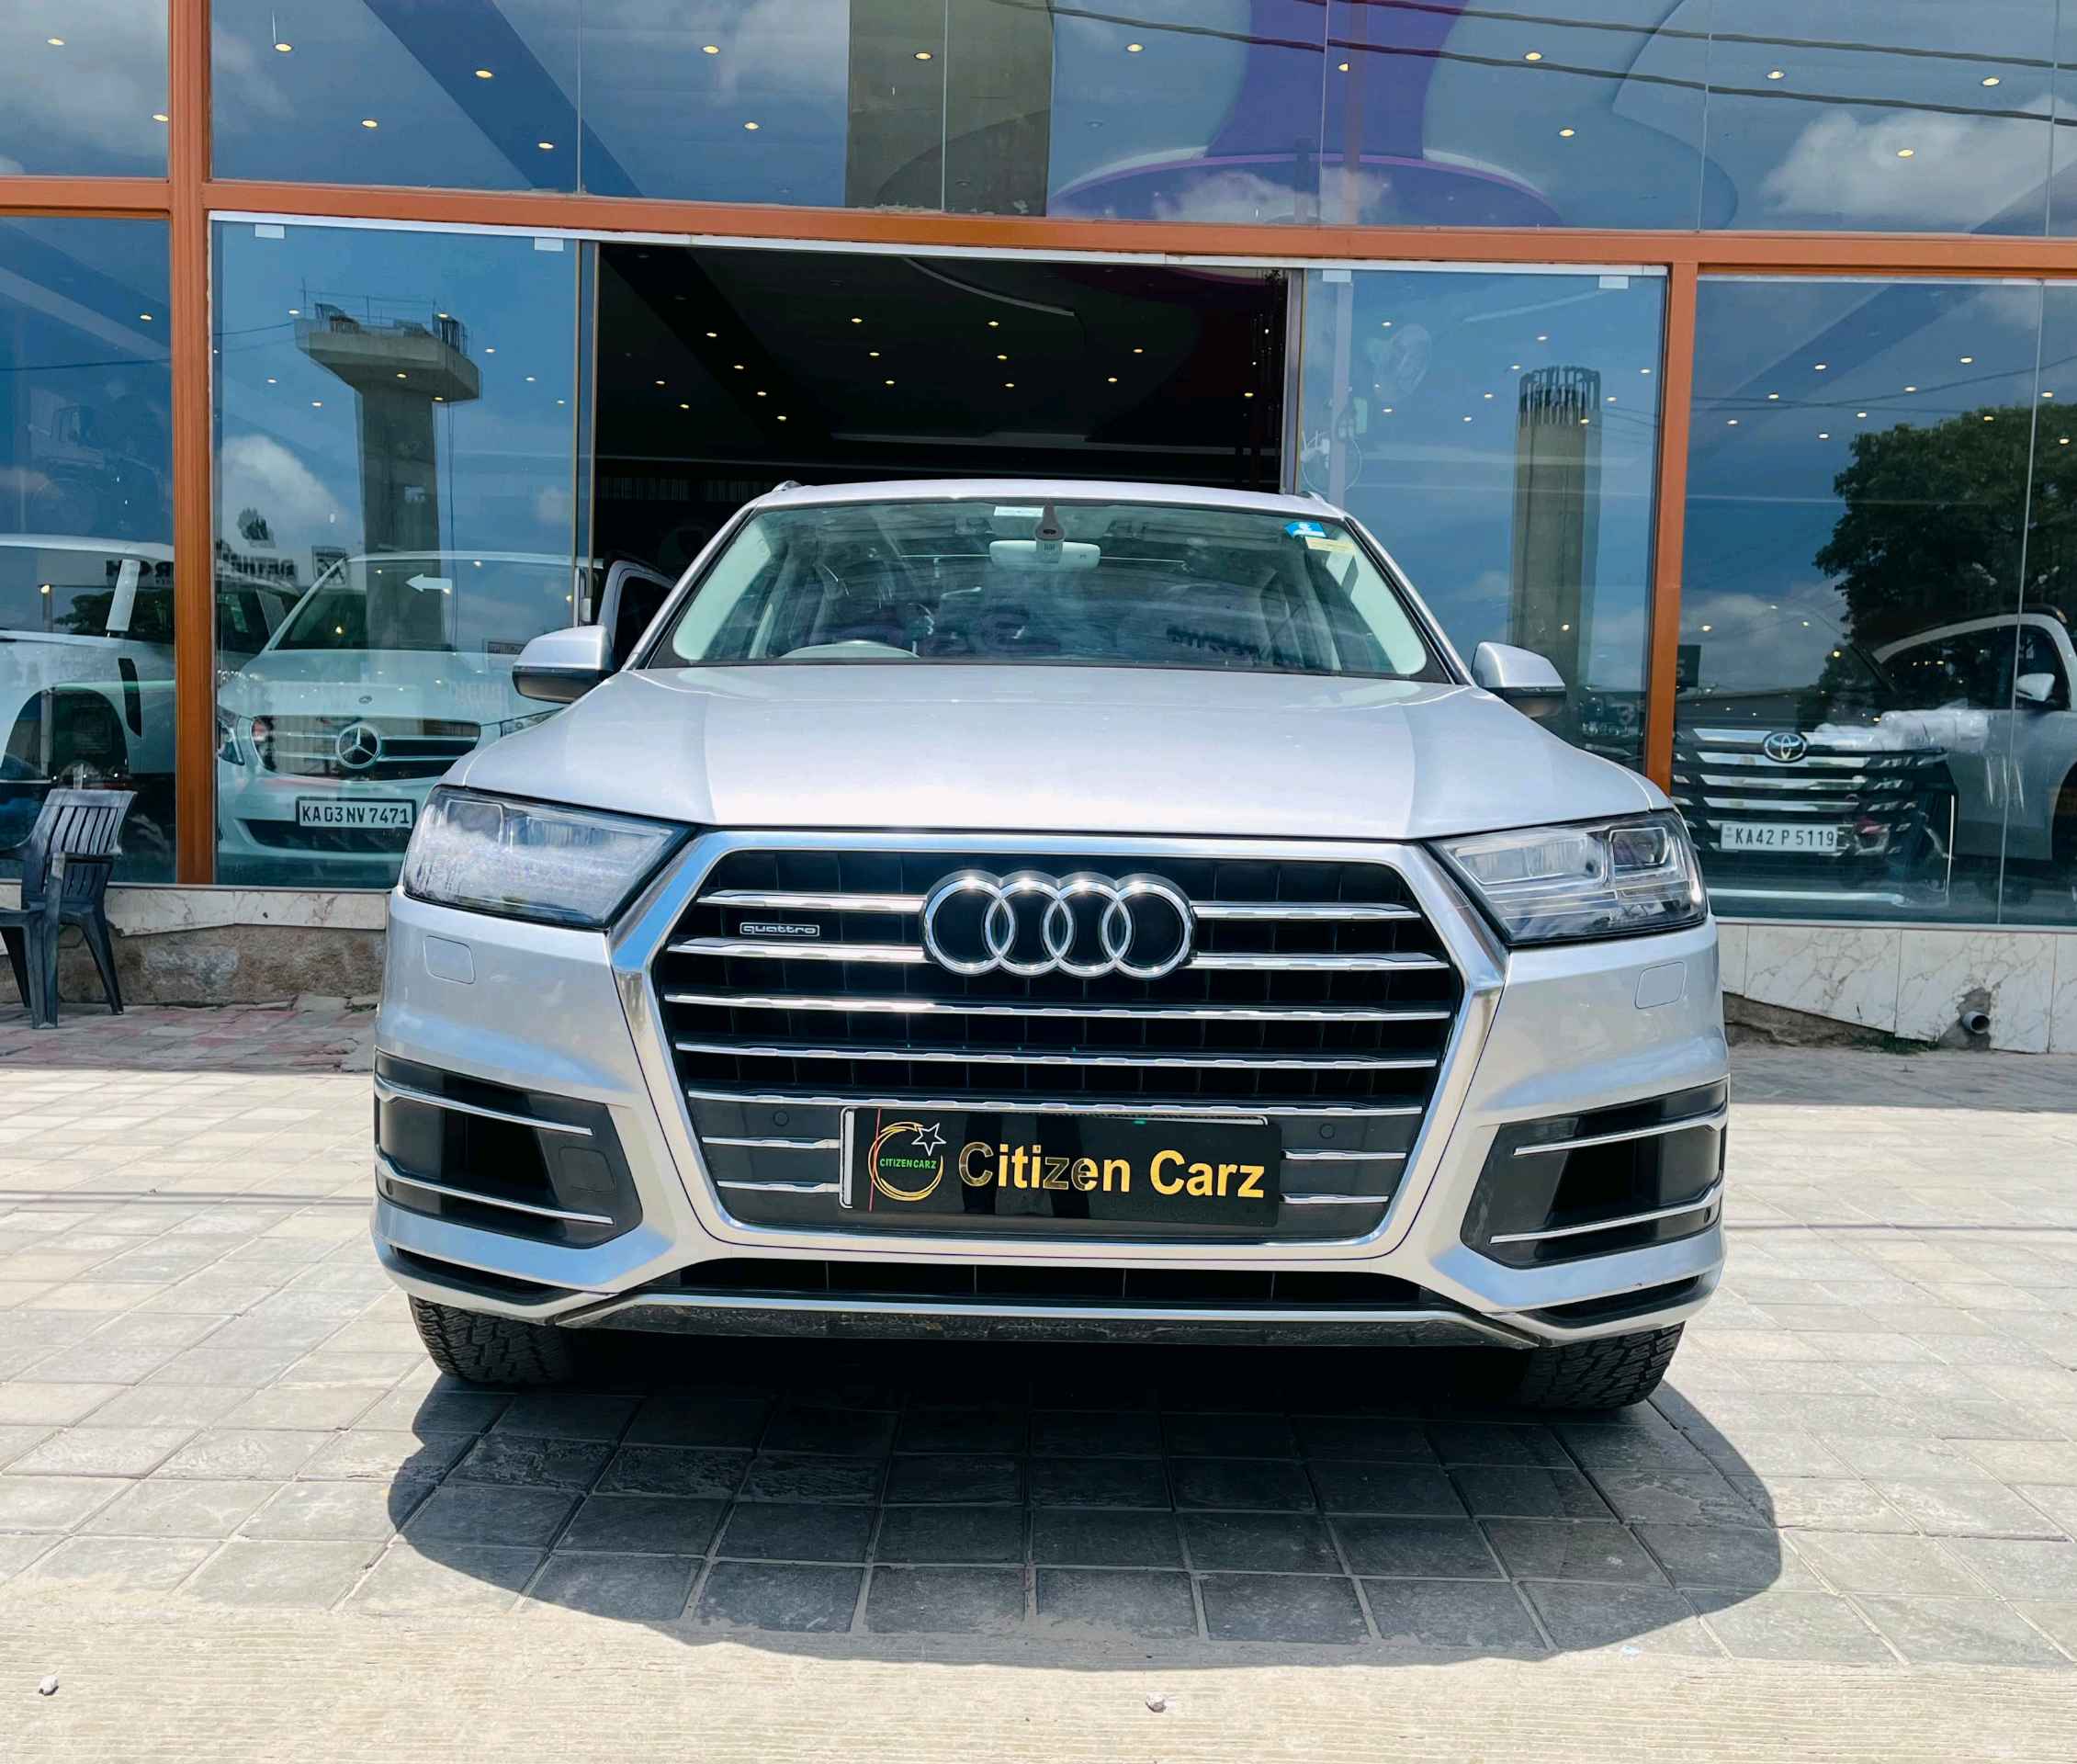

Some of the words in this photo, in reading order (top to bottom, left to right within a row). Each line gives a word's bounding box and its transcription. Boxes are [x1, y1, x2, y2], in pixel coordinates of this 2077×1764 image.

[1735, 828, 1775, 845] KA42
[1781, 830, 1790, 845] P
[1796, 831, 1834, 846] 5119
[742, 925, 817, 934] quattro
[958, 1141, 1131, 1193] Citizen
[1150, 1149, 1265, 1199] Carz
